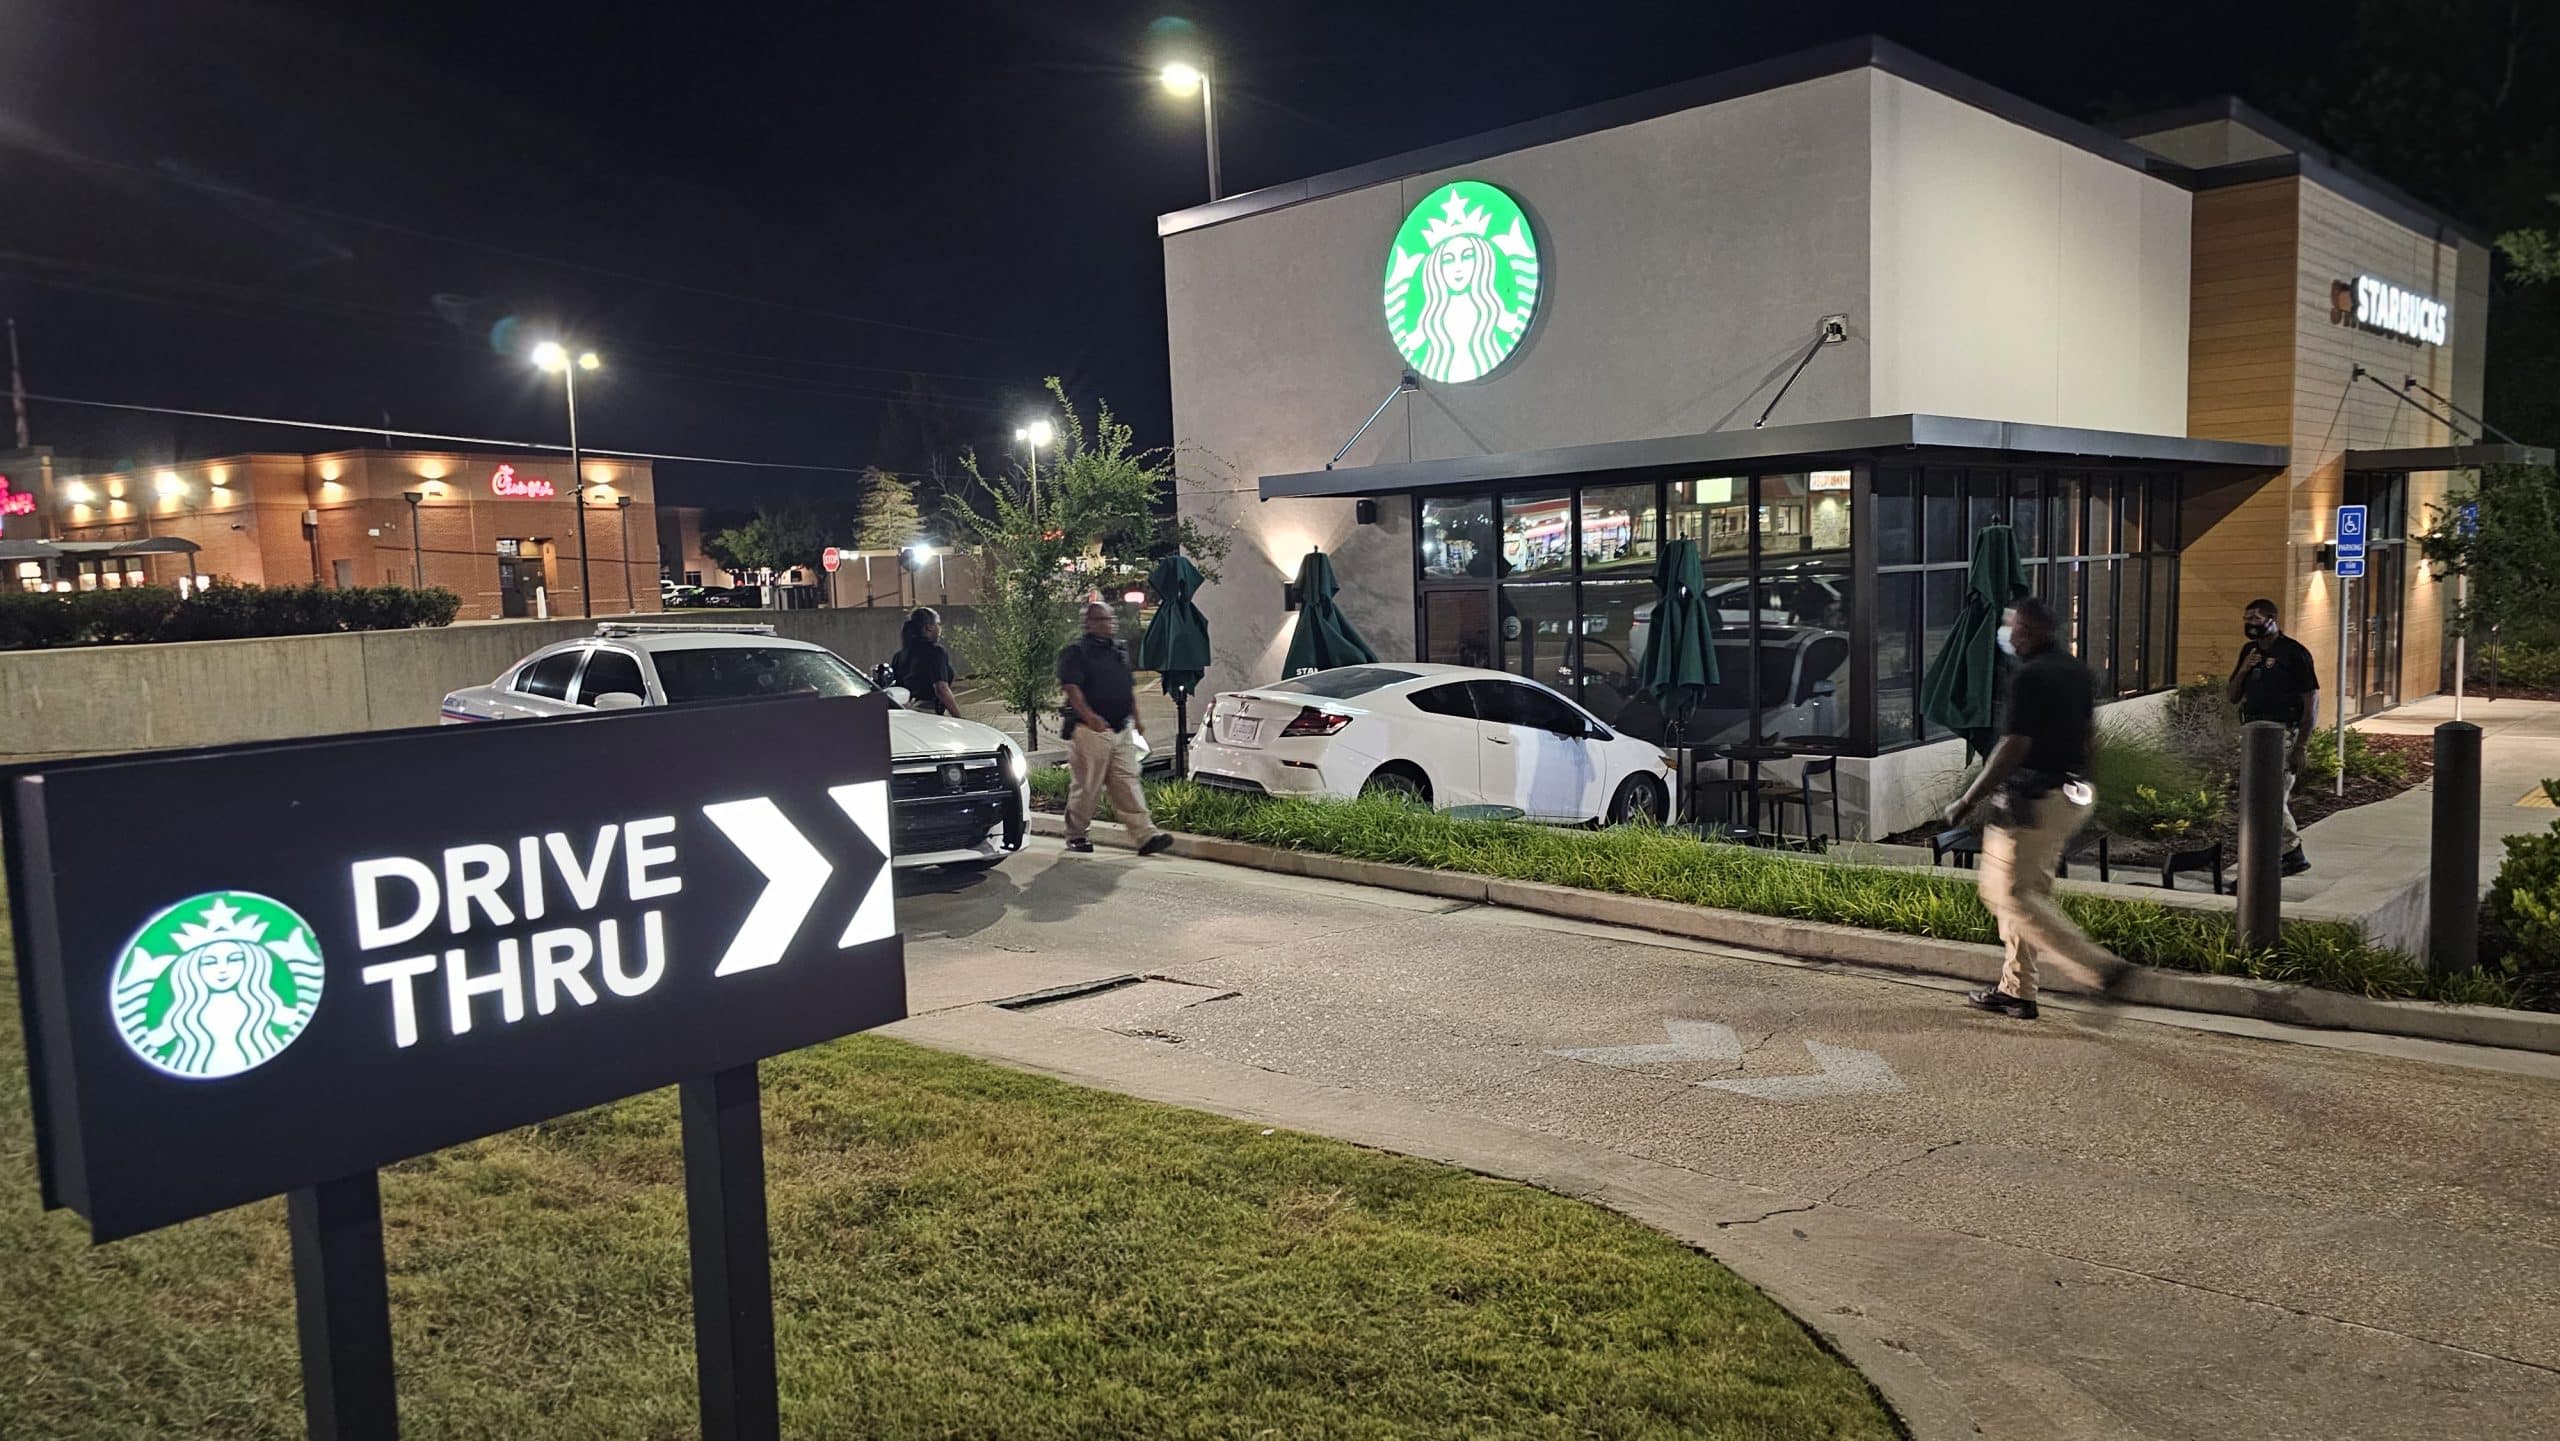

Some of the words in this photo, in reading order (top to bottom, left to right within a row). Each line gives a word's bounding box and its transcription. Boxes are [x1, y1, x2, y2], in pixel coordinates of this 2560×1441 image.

[2357, 275, 2447, 346] STARBUCKS
[352, 816, 682, 951] DRIVE
[362, 910, 666, 1048] THRU
